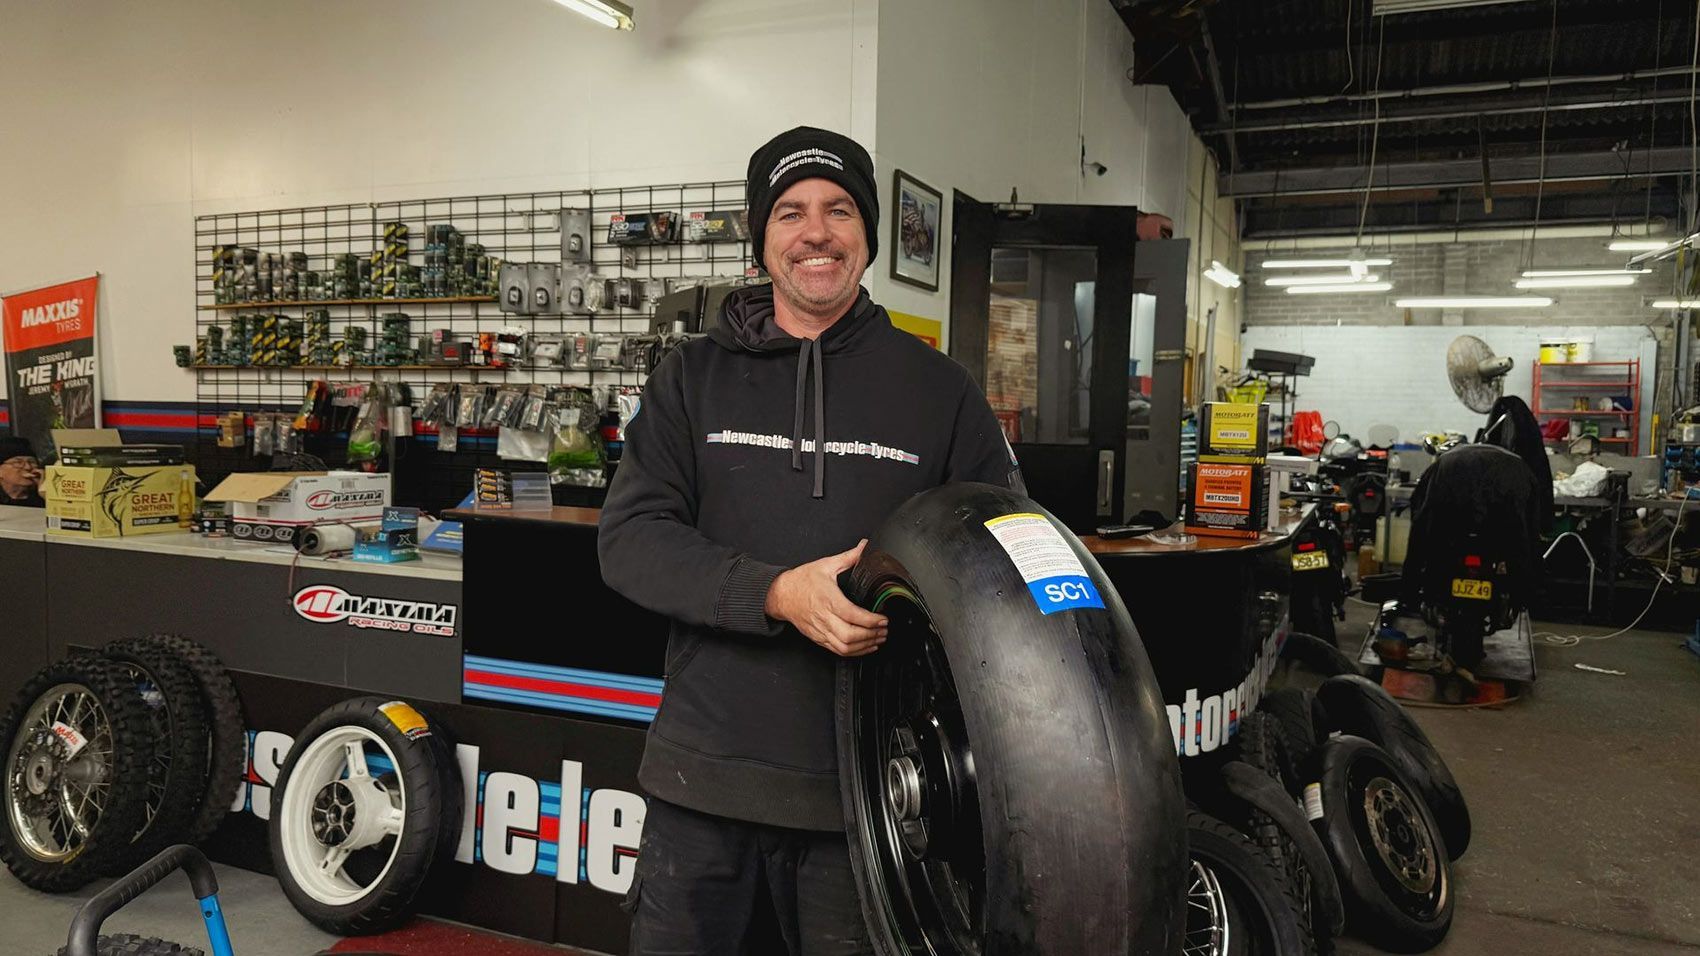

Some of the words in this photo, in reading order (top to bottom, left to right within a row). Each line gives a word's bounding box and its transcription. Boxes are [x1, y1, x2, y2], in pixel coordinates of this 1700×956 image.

[780, 148, 824, 165] Newcastle
[815, 156, 838, 168] Tyres
[21, 298, 79, 329] MAXXIS
[55, 318, 81, 333] TYRES
[38, 352, 65, 364] DESIGNED
[17, 364, 52, 388] THE
[28, 384, 51, 395] JEREMY
[1215, 412, 1255, 420] MOTOBATT
[721, 430, 791, 450] Newcastle
[870, 442, 904, 461] Tyres
[1200, 468, 1248, 477] MOTOBATT
[61, 480, 85, 489] GREAT
[131, 493, 174, 505] GREAT
[330, 491, 383, 503] MAXIMA
[131, 503, 175, 514] NORTHERN
[1044, 582, 1090, 603] SC1
[1453, 583, 1474, 596] JJZ
[1477, 585, 1489, 597] 49
[336, 597, 455, 624] MAXIMA
[350, 617, 410, 631] RACING
[414, 625, 453, 635] OILS
